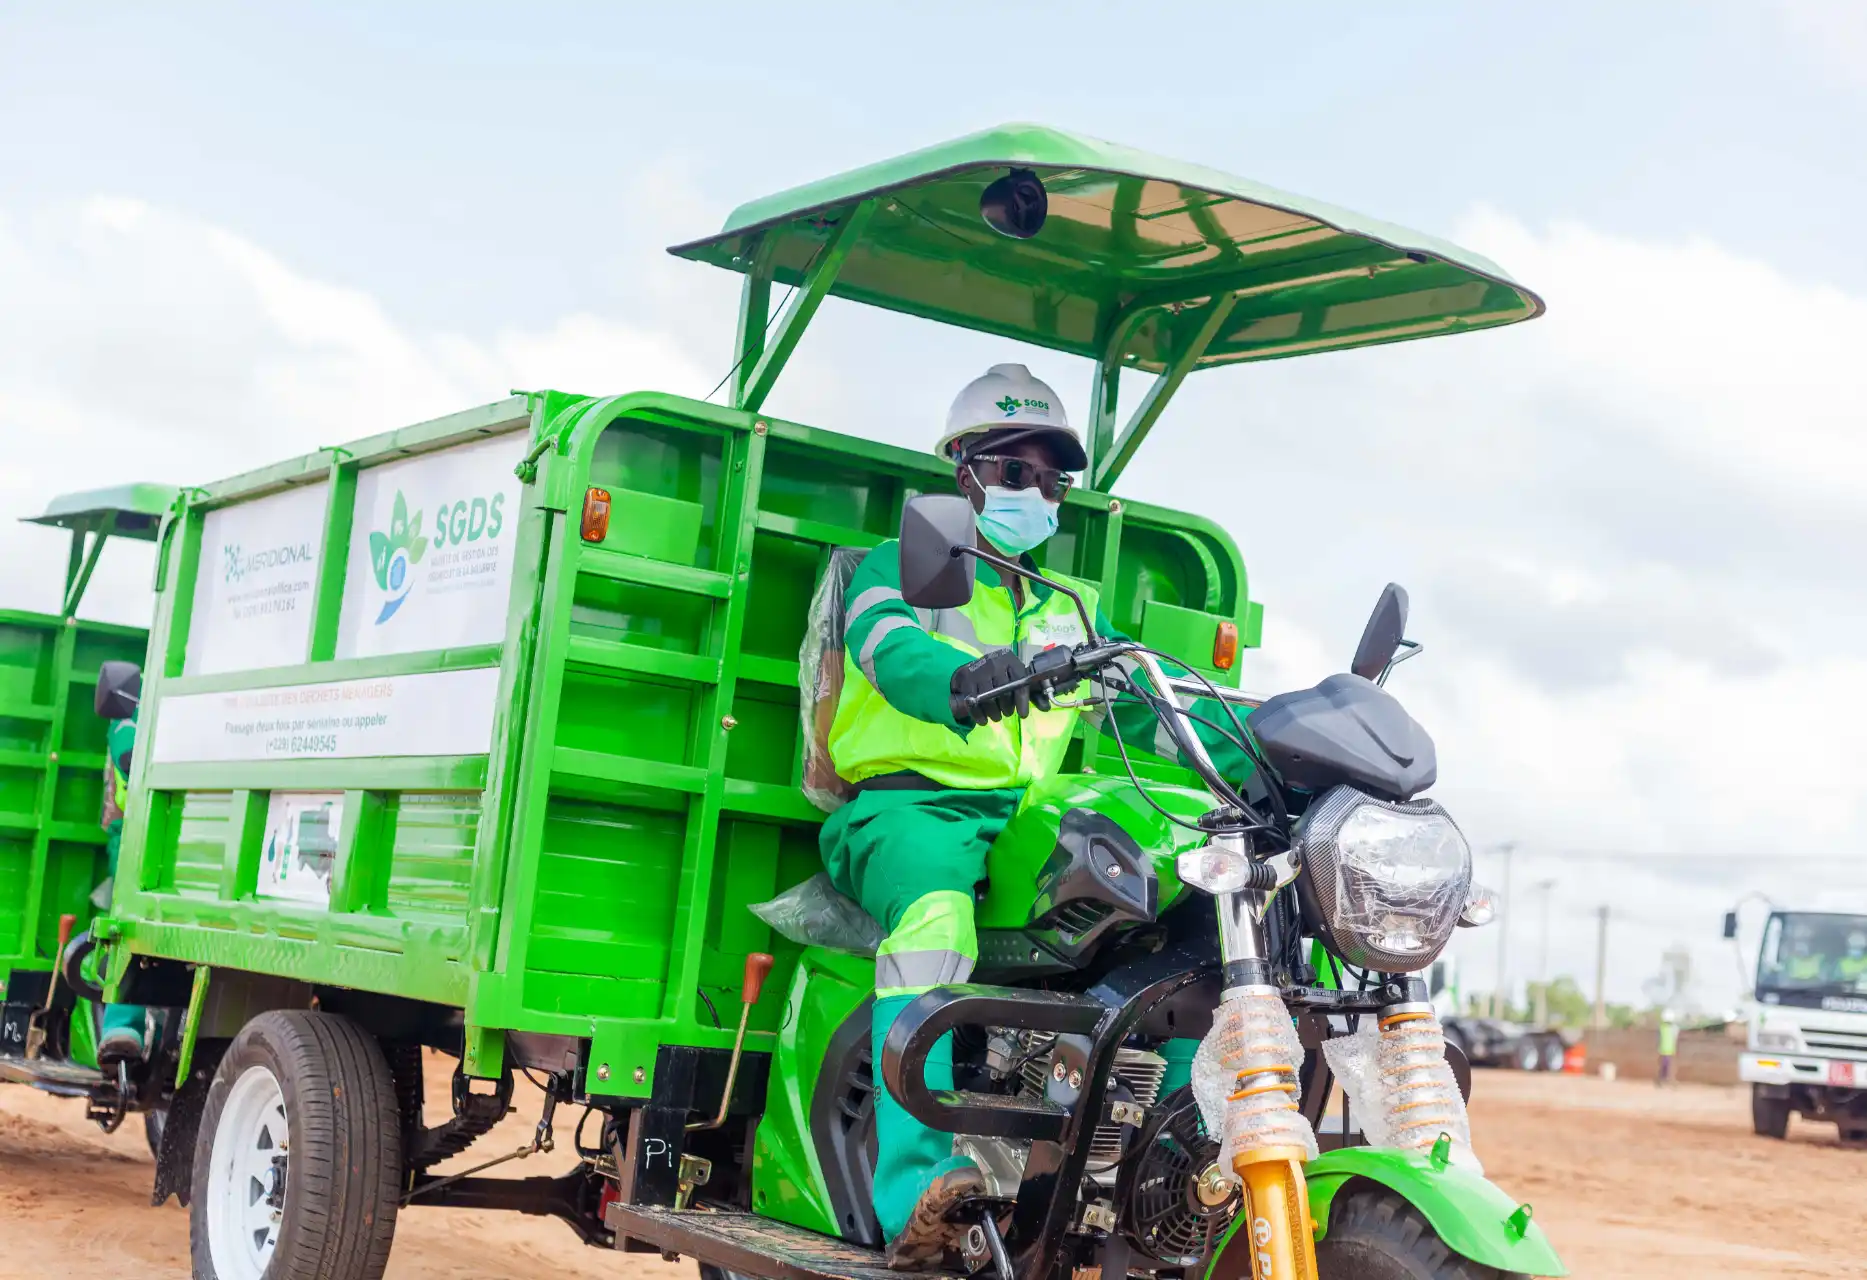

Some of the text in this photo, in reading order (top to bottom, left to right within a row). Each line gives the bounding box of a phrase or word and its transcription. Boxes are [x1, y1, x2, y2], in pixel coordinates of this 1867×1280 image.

[1024, 398, 1049, 410] SGDS
[433, 491, 505, 549] SGDS
[225, 721, 255, 737] Passage
[256, 719, 274, 733] deux
[275, 719, 291, 732] fois
[292, 719, 305, 734] par
[342, 716, 353, 727] ou
[354, 712, 388, 729] appeler
[290, 734, 337, 753] 62449545
